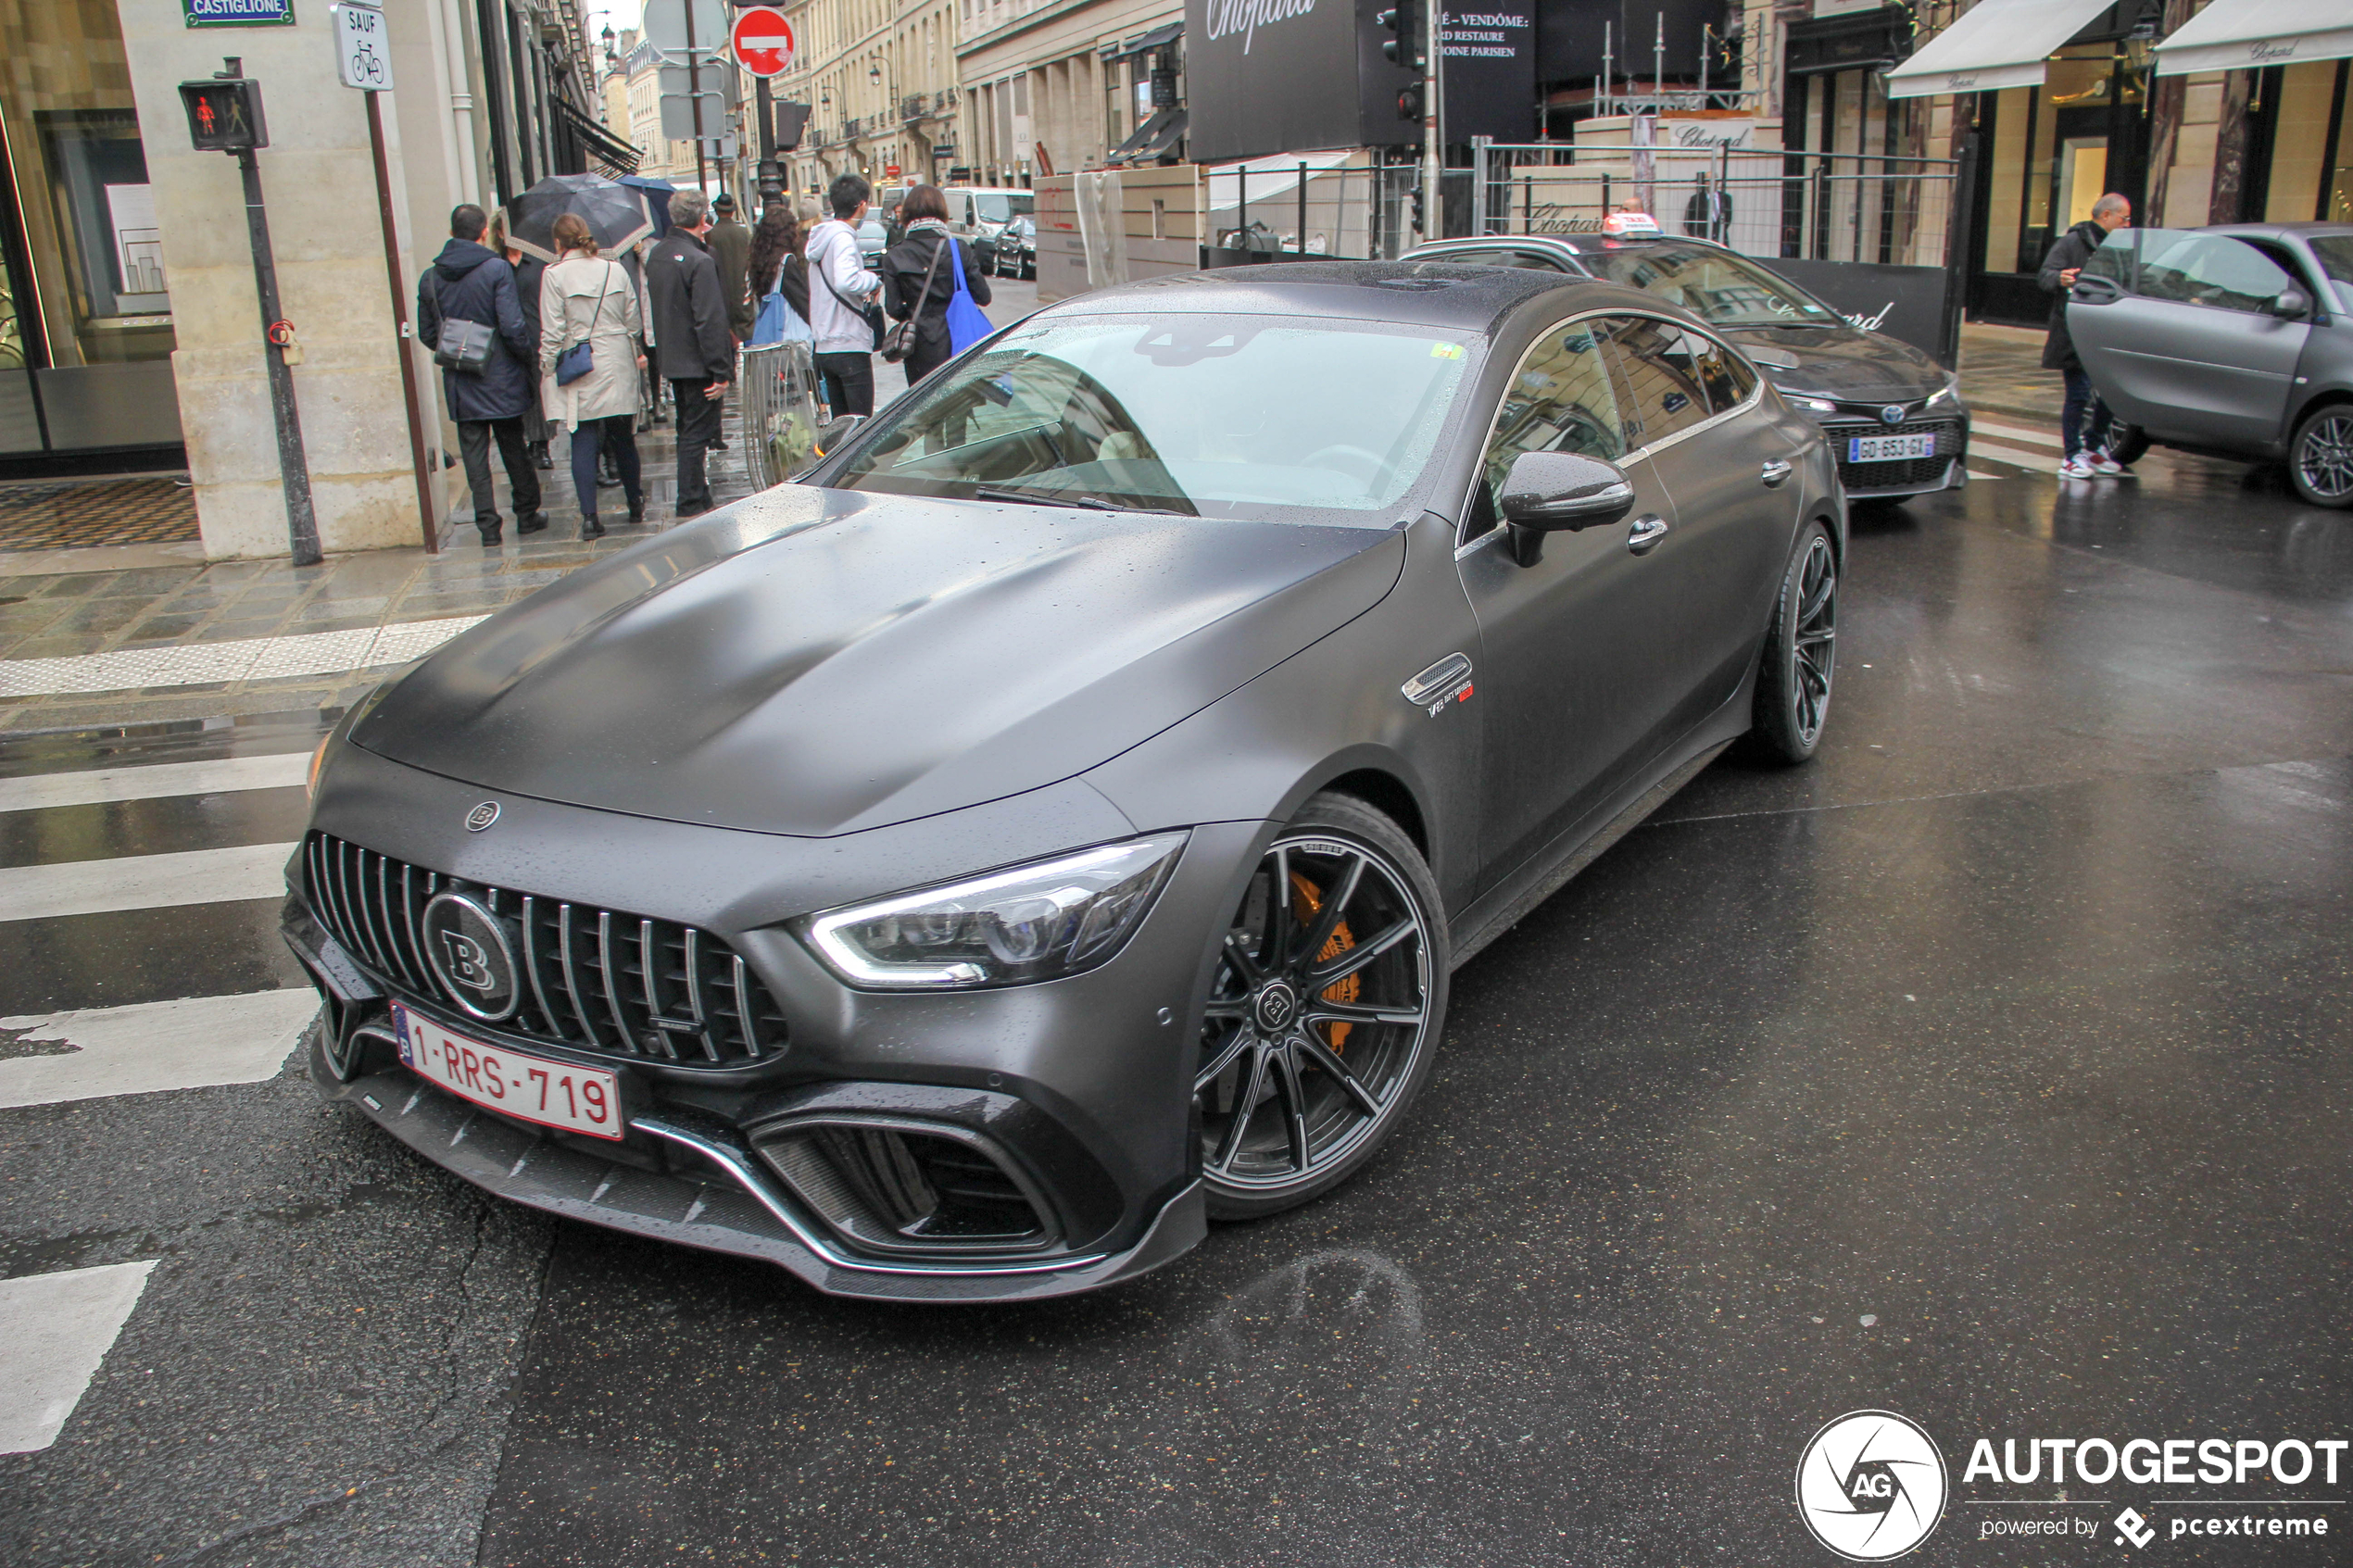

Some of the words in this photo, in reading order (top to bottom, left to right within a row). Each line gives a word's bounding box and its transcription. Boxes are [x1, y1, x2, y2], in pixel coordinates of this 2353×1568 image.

[194, 0, 283, 14] CASTIGLIONE
[348, 11, 375, 33] SAUF
[1460, 13, 1529, 27] VENDÔME:
[1454, 31, 1505, 42] RESTAURE
[1471, 47, 1516, 56] PARISIEN
[2249, 38, 2300, 62] Chopard
[1522, 201, 1604, 234] Chopar
[1427, 699, 1444, 719] V8
[469, 806, 495, 825] B
[441, 929, 496, 991] B
[1264, 991, 1290, 1024] B
[399, 1038, 411, 1058] B
[415, 1025, 608, 1124] 1-RRS-719
